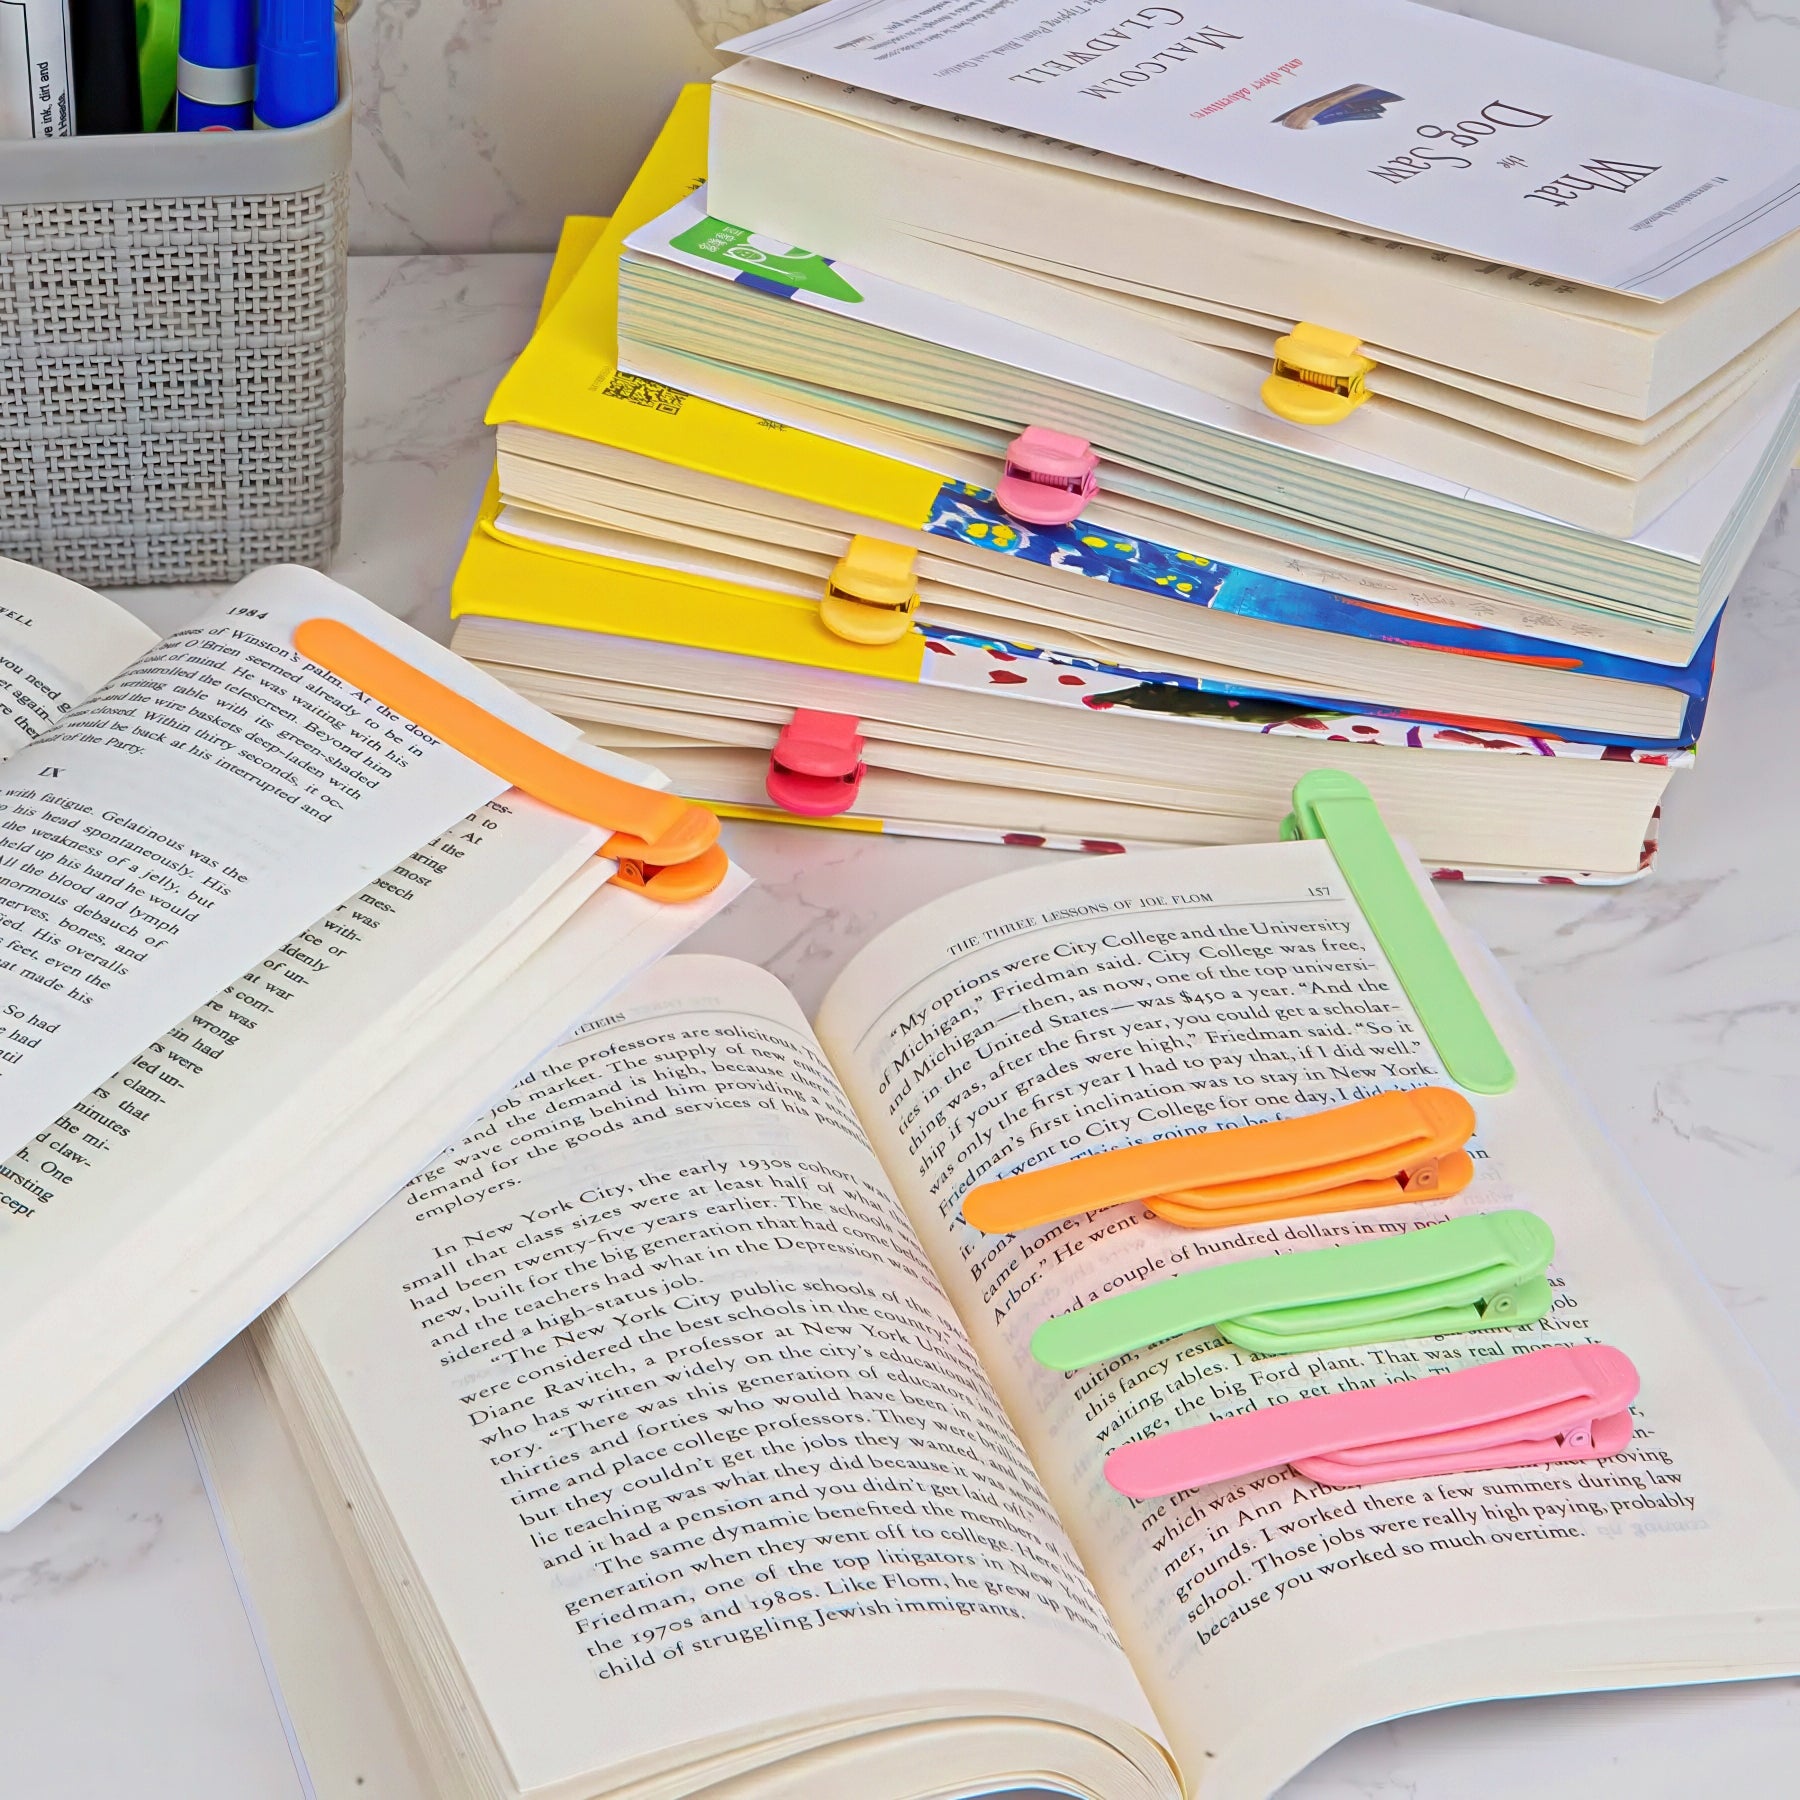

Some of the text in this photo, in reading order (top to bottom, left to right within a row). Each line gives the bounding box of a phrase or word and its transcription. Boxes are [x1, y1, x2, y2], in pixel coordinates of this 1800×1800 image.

[36, 61, 49, 82] and
[1008, 7, 1184, 84] GLADWELL
[1078, 25, 1244, 100] MALCOLM
[39, 84, 50, 101] dirt
[40, 104, 52, 124] ink,
[1368, 100, 1553, 184] Dog Saw
[1497, 154, 1526, 169] the
[1523, 158, 1662, 207] What
[227, 608, 268, 619] 1984
[24, 675, 62, 701] need
[168, 653, 189, 661] of
[232, 666, 255, 680] He
[260, 679, 287, 695] was
[292, 696, 346, 730] waiting
[350, 729, 381, 751] with
[384, 750, 408, 767] his
[245, 656, 304, 683] seemed
[305, 684, 361, 716] already
[364, 718, 379, 729] to
[384, 729, 403, 744] be
[408, 744, 423, 757] in
[302, 664, 342, 689] palm.
[349, 691, 372, 704] At
[376, 706, 399, 721] the
[405, 724, 440, 745] door
[172, 686, 380, 788] table with its green-shaded
[1, 821, 26, 832] the
[32, 829, 103, 856] weakness
[107, 856, 131, 866] of
[187, 890, 215, 908] but
[6, 789, 36, 799] with
[102, 811, 184, 850] Gelatinous
[190, 850, 219, 868] was
[222, 867, 247, 882] the
[358, 894, 395, 913] mes-
[393, 866, 432, 886] most
[1308, 887, 1330, 896] 157
[32, 928, 128, 975] His overalls
[324, 920, 361, 941] with-
[328, 946, 347, 956] or
[947, 894, 1213, 955] THE THREE LESSONS OF JOE FLOM
[263, 960, 309, 984] of un-
[266, 983, 294, 1000] war
[932, 969, 1000, 1010] options
[1003, 953, 1050, 971] were
[1054, 942, 1096, 957] City
[1102, 931, 1177, 947] College
[1182, 925, 1214, 940] and
[1219, 923, 1249, 937] the
[1249, 919, 1350, 936] University
[193, 1015, 240, 1045] wrong
[236, 992, 274, 1013] com-
[879, 1068, 890, 1094] of
[991, 967, 1088, 1002] Friedman
[1097, 953, 1141, 971] said.
[1148, 950, 1190, 964] City
[1199, 944, 1274, 959] College
[1279, 945, 1316, 953] was
[1322, 939, 1365, 951] free,
[192, 1038, 224, 1059] had
[909, 1110, 947, 1155] thing
[946, 1083, 986, 1109] was,
[990, 1053, 1032, 1081] after
[1038, 1040, 1070, 1056] the
[1075, 1028, 1116, 1044] first
[1120, 1020, 1169, 1038] year,
[1172, 1015, 1211, 1029] you
[1216, 1005, 1270, 1021] could
[1274, 1008, 1305, 1021] get
[1323, 1000, 1399, 1015] scholar-
[432, 1160, 858, 1259] In New York City, the early 1930s cohort
[441, 1274, 703, 1366] sidered a high-status job.
[595, 1500, 955, 1574] The same dynamic benefited the
[1176, 1470, 1681, 1603] grounds. I worked there a few summers during law
[1188, 1492, 1694, 1623] school. Those jobs were really high paying, probably
[587, 1572, 979, 1657] the 1970s and 1980s. Like Flom, he
[1197, 1528, 1585, 1645] because you worked so much overtime.
[599, 1599, 1025, 1679] child of struggling Jewish immigrants.
